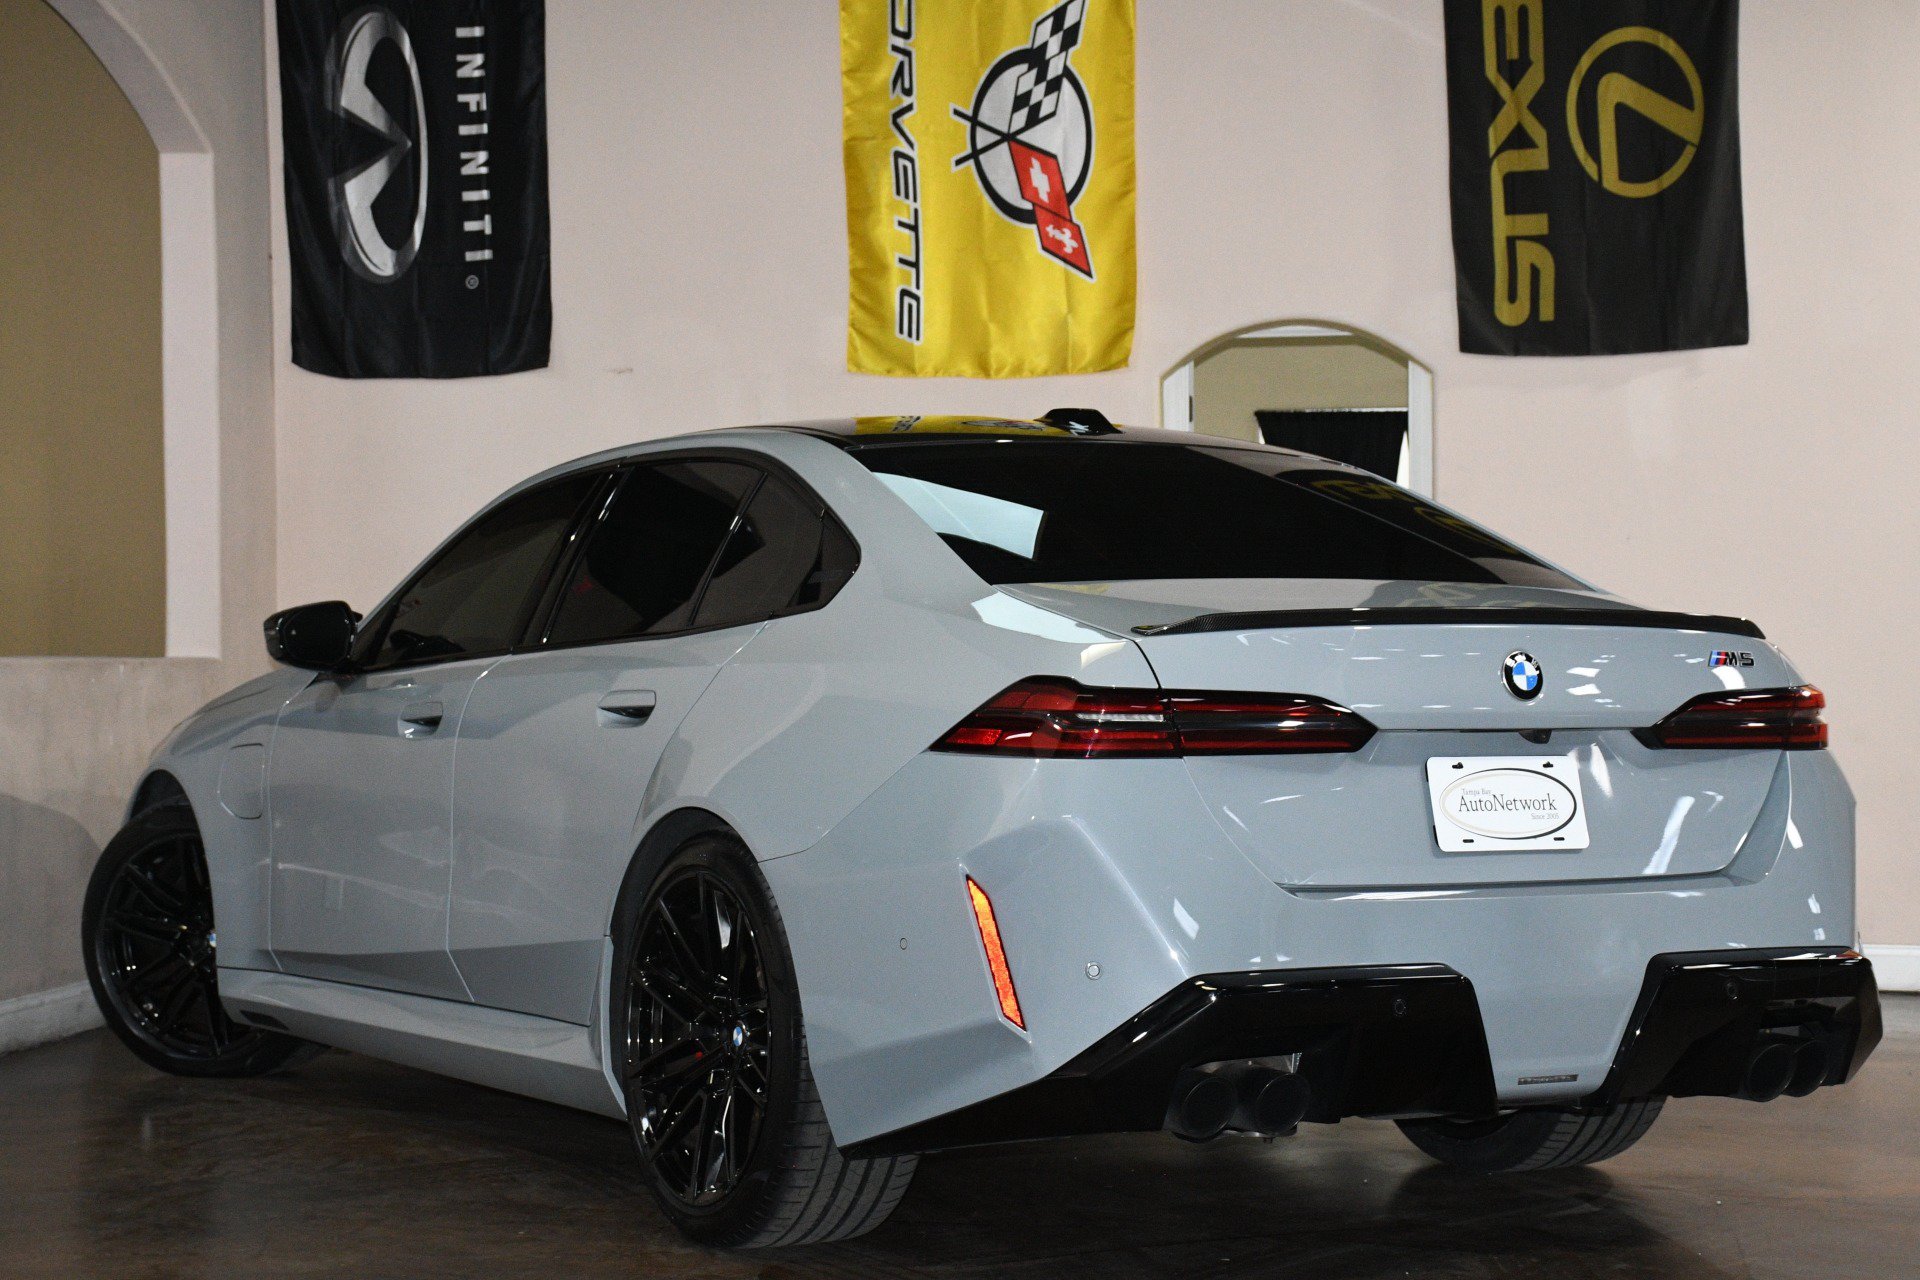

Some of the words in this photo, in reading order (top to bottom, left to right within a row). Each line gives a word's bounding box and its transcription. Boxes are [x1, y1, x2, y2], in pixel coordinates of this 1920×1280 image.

[455, 26, 493, 262] INFINITI
[1722, 650, 1755, 667] M5
[1461, 788, 1480, 797] Tampa
[1481, 788, 1492, 796] Bay
[1459, 793, 1558, 812] AutoNetwork
